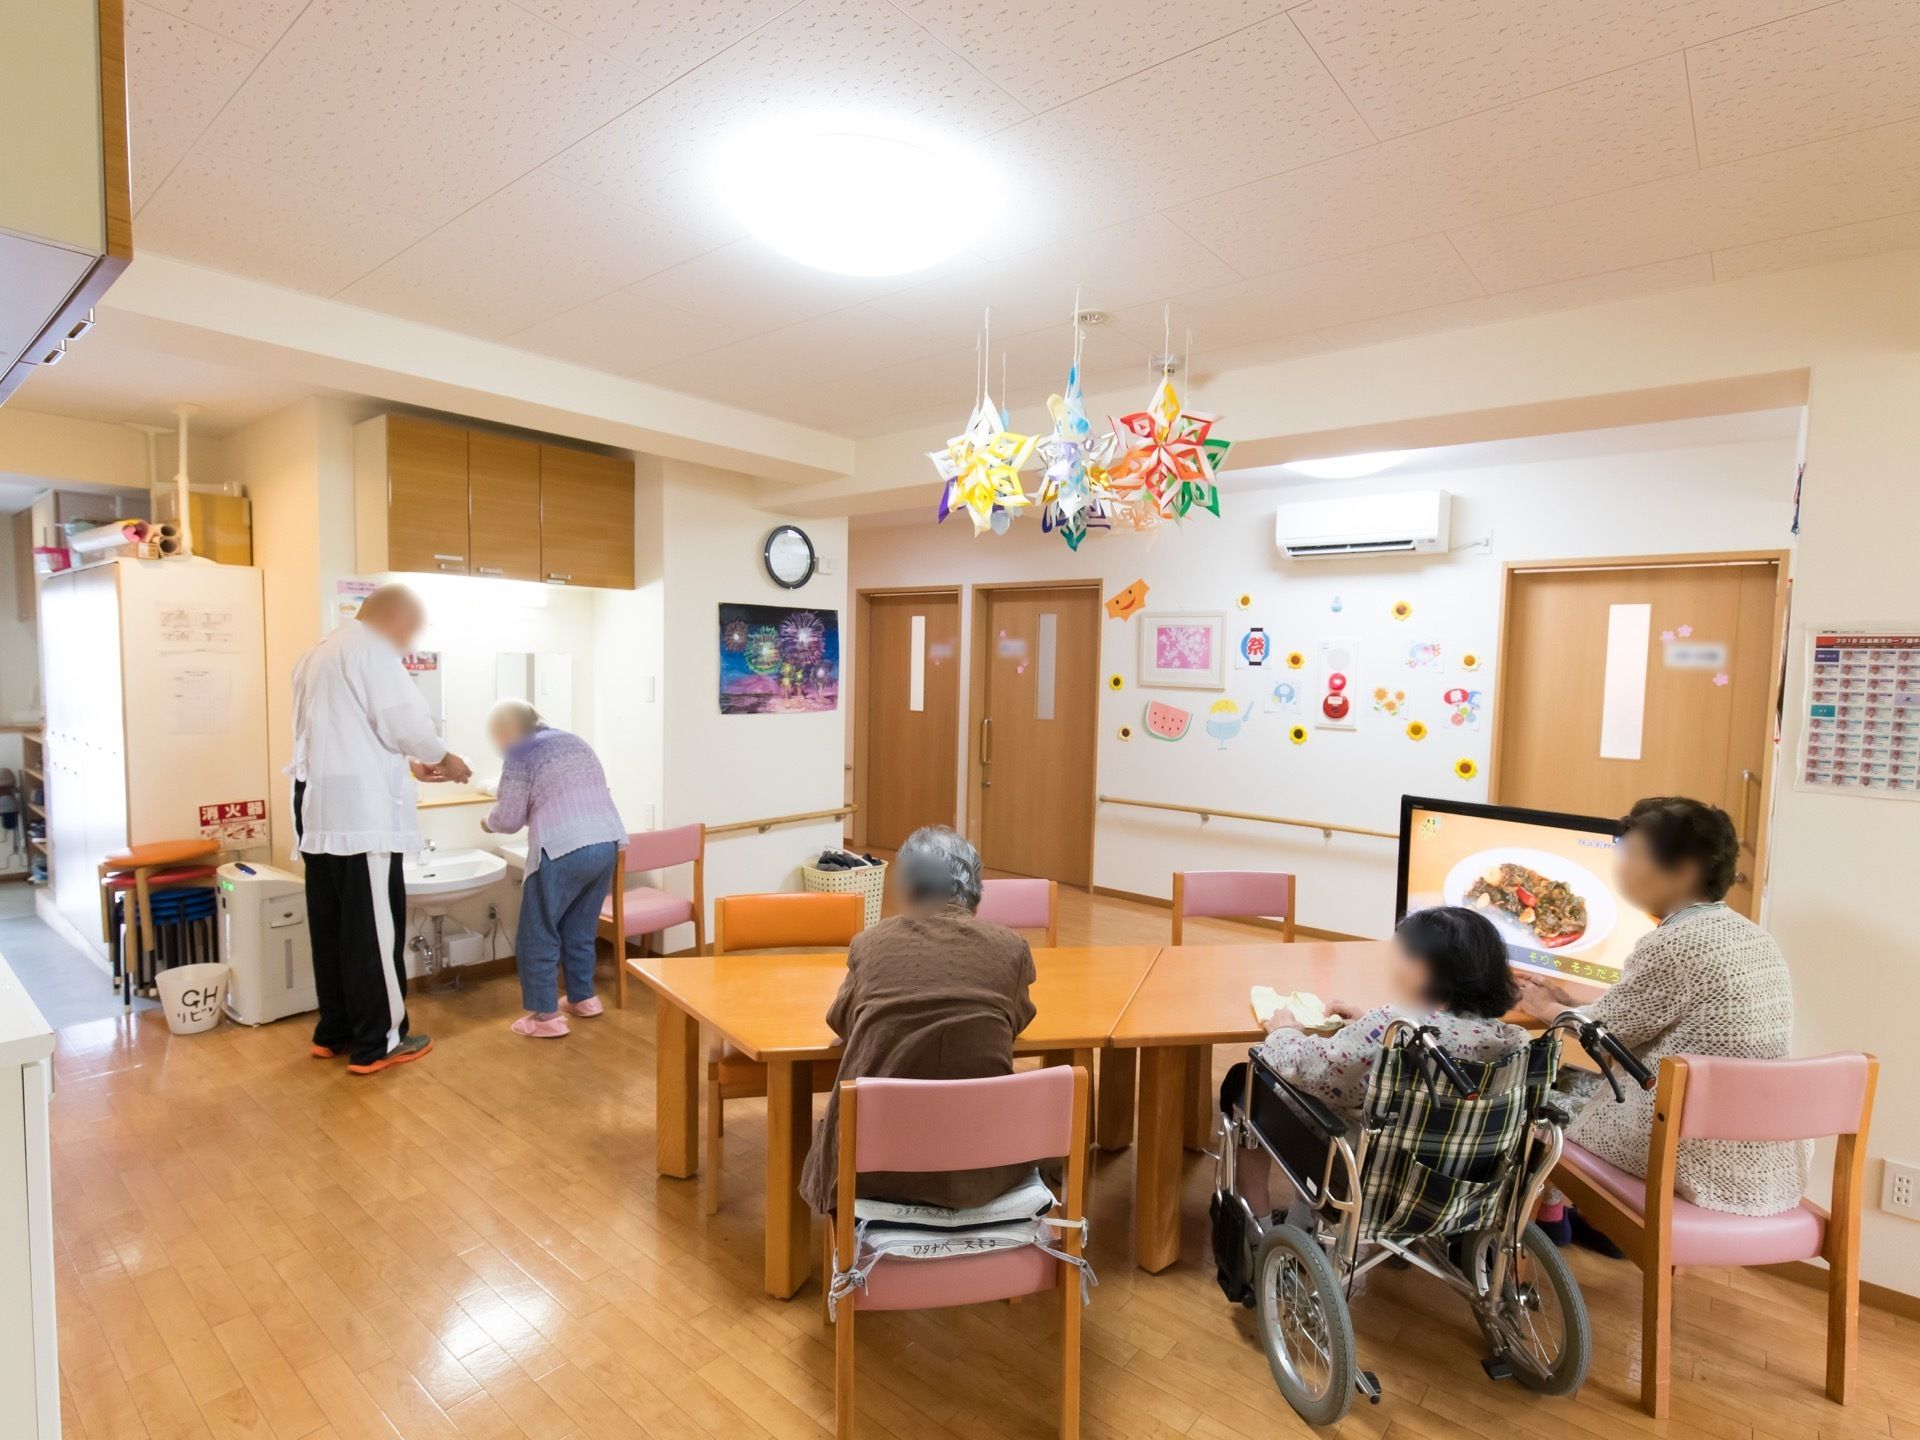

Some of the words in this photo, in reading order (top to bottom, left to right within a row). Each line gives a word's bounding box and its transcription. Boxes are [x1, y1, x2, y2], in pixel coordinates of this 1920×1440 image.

[1247, 637, 1264, 655] 祭
[201, 801, 264, 821] 消火器
[1528, 951, 1562, 968] そりゃ
[181, 985, 219, 1008] GH
[912, 1240, 952, 1256] ワタナベ
